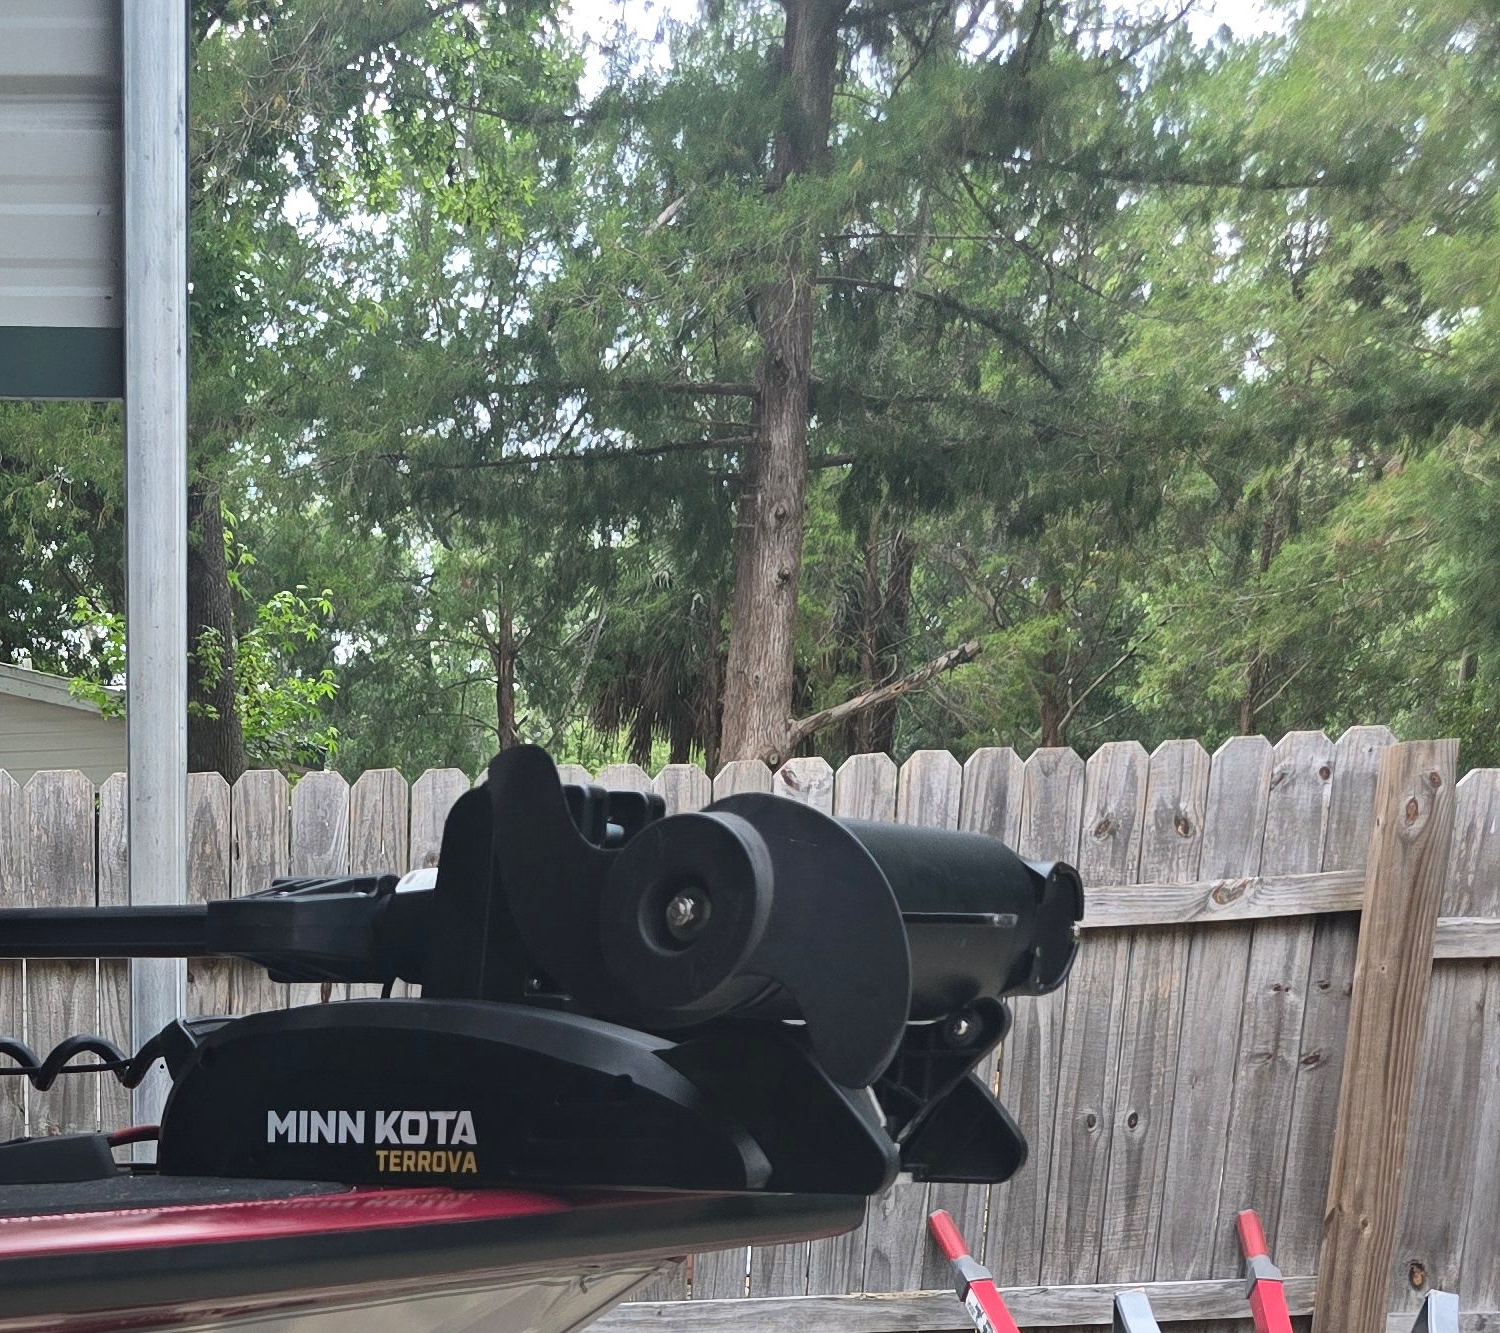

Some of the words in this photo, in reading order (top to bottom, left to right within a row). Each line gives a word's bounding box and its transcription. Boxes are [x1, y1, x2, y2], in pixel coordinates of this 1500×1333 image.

[267, 1110, 365, 1143] MINN
[374, 1110, 478, 1145] KOTA
[376, 1150, 478, 1173] TERROVA
